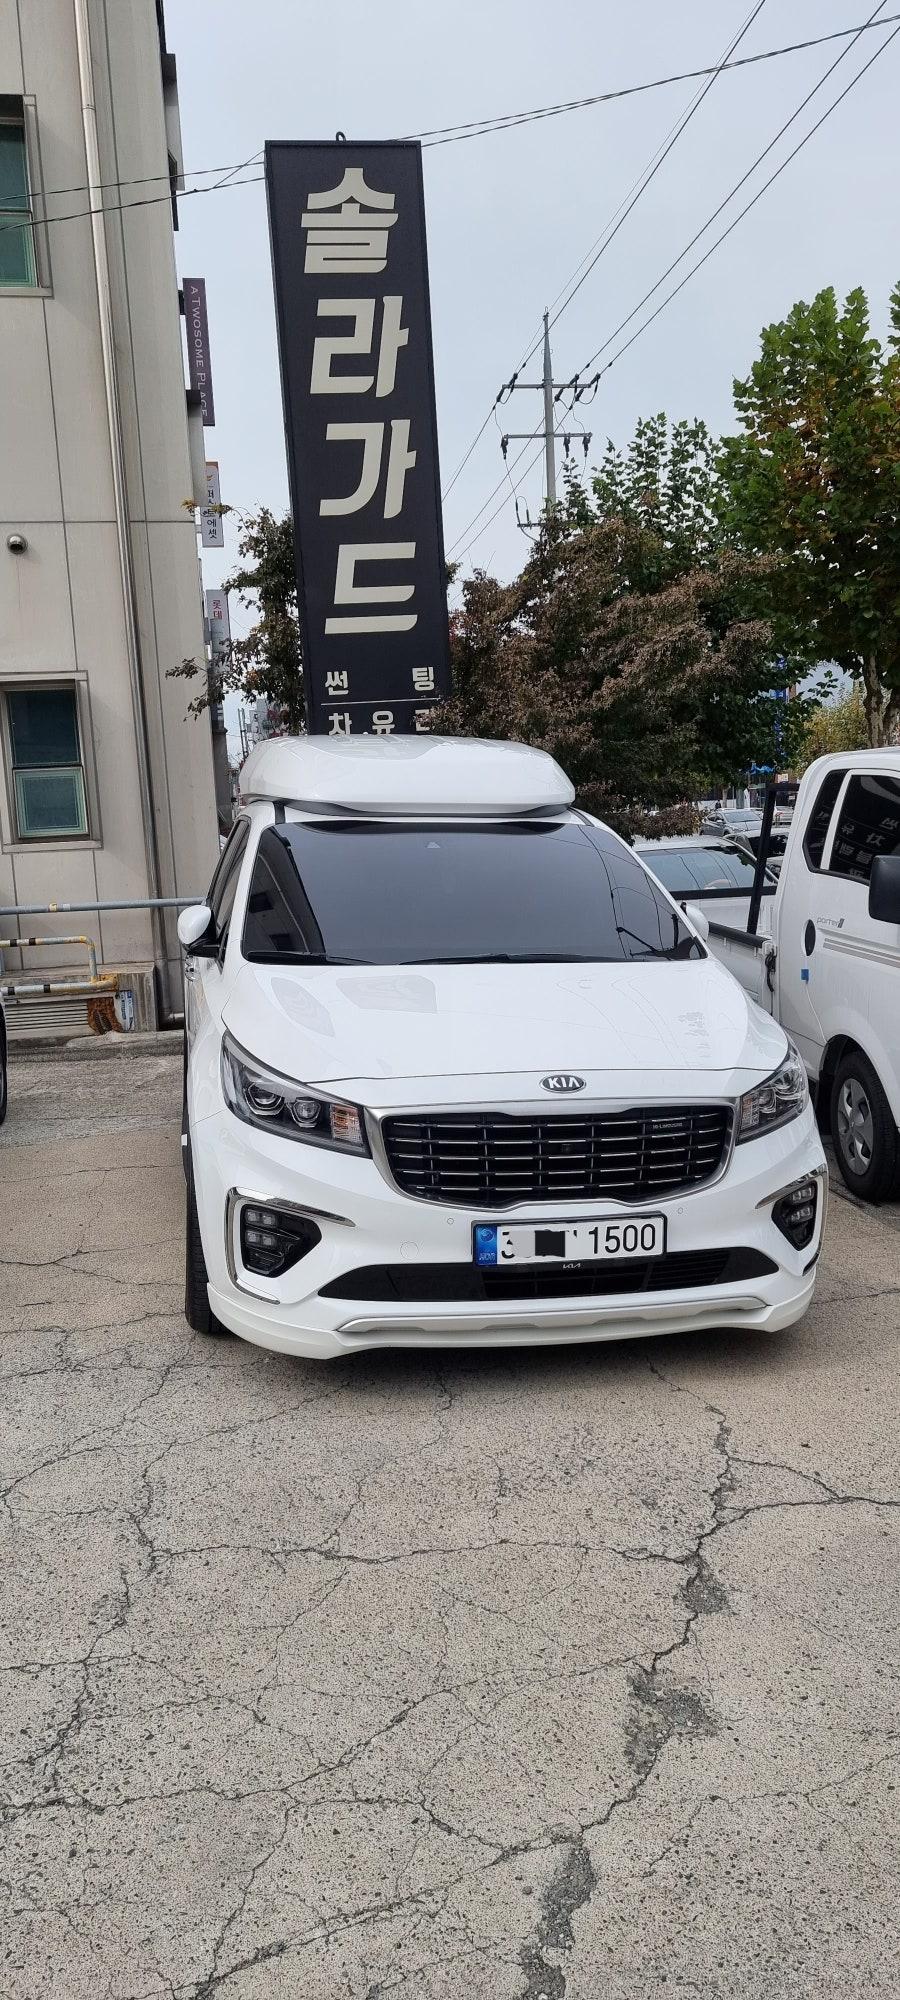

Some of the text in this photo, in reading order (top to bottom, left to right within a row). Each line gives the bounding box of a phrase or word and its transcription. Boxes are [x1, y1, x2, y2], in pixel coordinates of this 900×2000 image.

[190, 285, 199, 294] A
[191, 297, 204, 368] TWOSOME
[301, 167, 418, 635] 솔라가드
[212, 599, 223, 620] 롯데
[548, 1076, 580, 1089] KIA
[588, 1223, 656, 1254] 1500
